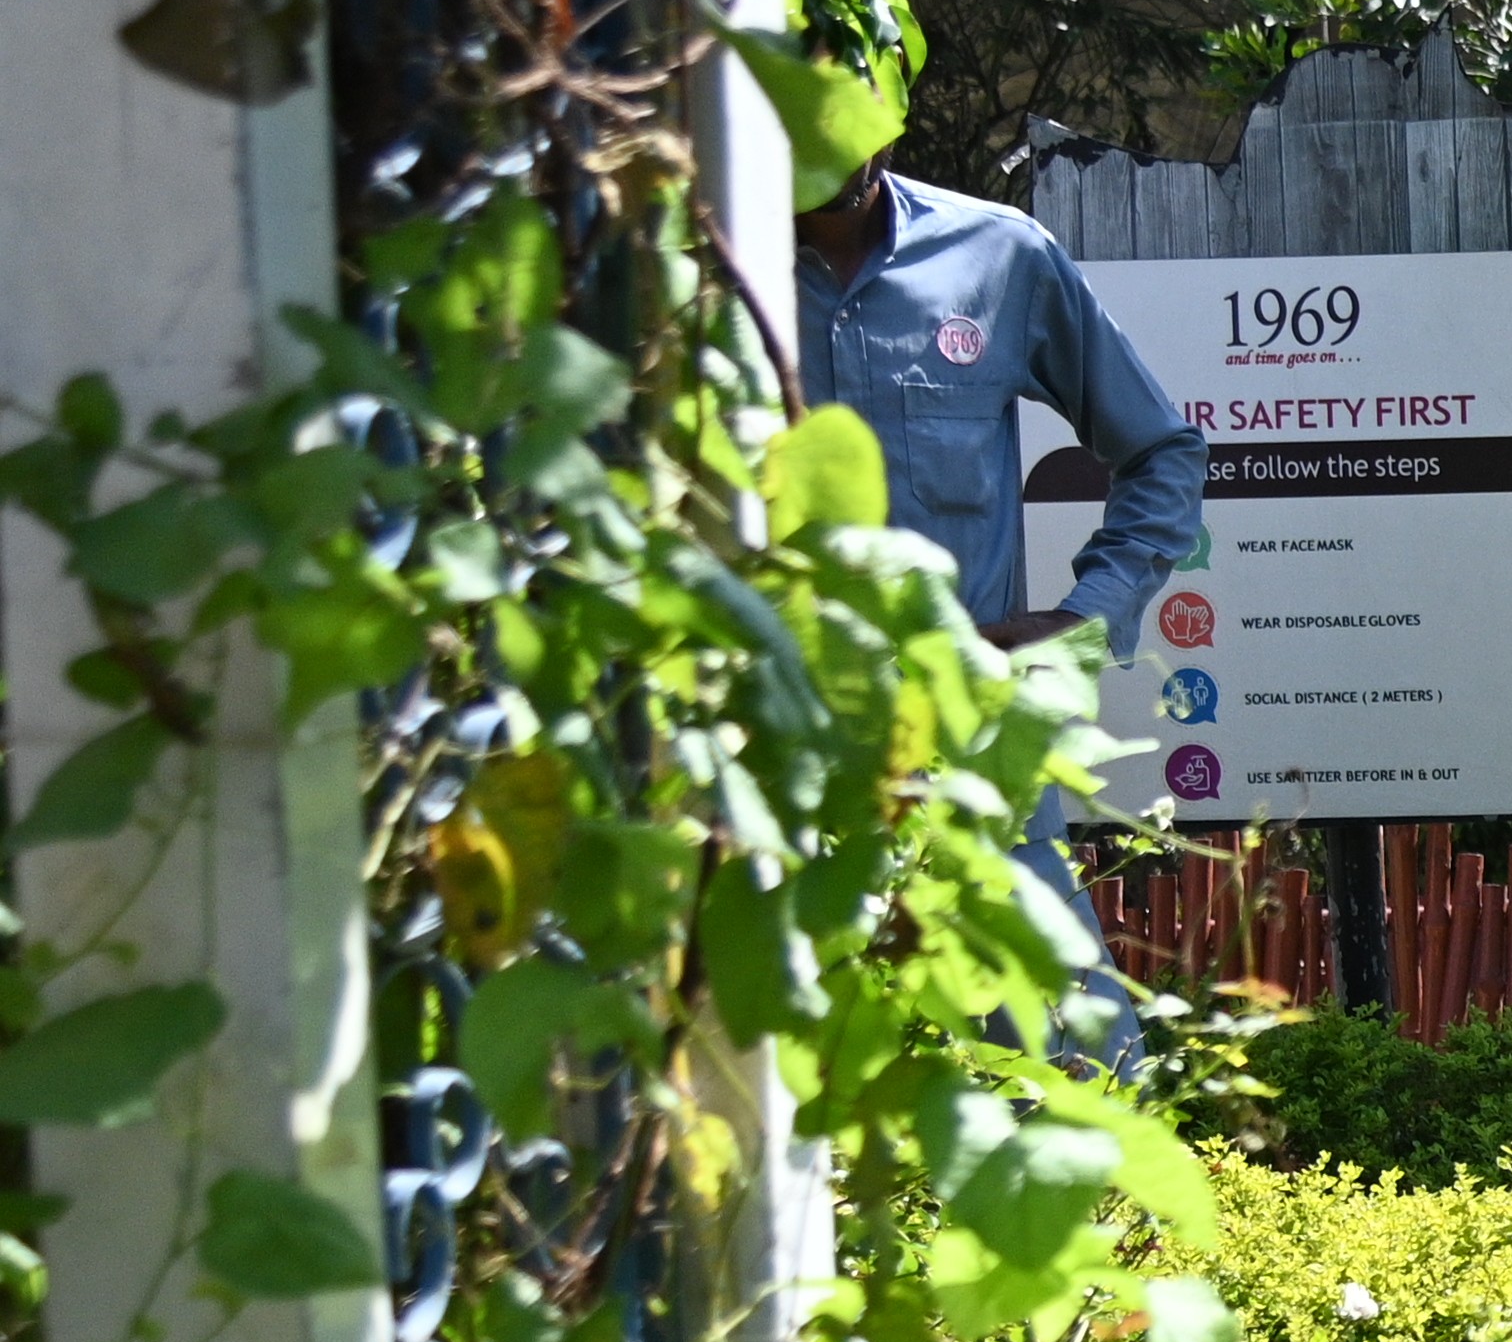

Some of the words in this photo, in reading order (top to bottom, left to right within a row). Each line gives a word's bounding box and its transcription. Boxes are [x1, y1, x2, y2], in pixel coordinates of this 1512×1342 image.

[1223, 285, 1361, 348] 1969
[944, 328, 980, 355] 1969
[1225, 350, 1251, 366] and
[1255, 351, 1284, 365] time
[1287, 353, 1316, 369] goes
[1229, 398, 1366, 431] SAFETY
[1375, 395, 1476, 427] FIRST
[1204, 462, 1236, 481] se
[1242, 455, 1320, 480] follow
[1327, 453, 1369, 479] the
[1374, 454, 1441, 482] steps
[1237, 540, 1277, 553] WEAR
[1241, 617, 1281, 629] WEAR
[1286, 615, 1367, 628] DISPOSABLE
[1368, 614, 1421, 627] GLOVES
[1245, 693, 1291, 705] SOCIAL
[1295, 691, 1358, 704] DISTANCE
[1382, 690, 1434, 702] METERS
[1247, 772, 1272, 784] USE
[1276, 770, 1342, 783] SANITIZER
[1346, 770, 1397, 782] BEFORE
[1401, 769, 1414, 781] IN
[1418, 769, 1428, 781] &
[1432, 768, 1460, 781] OUT
